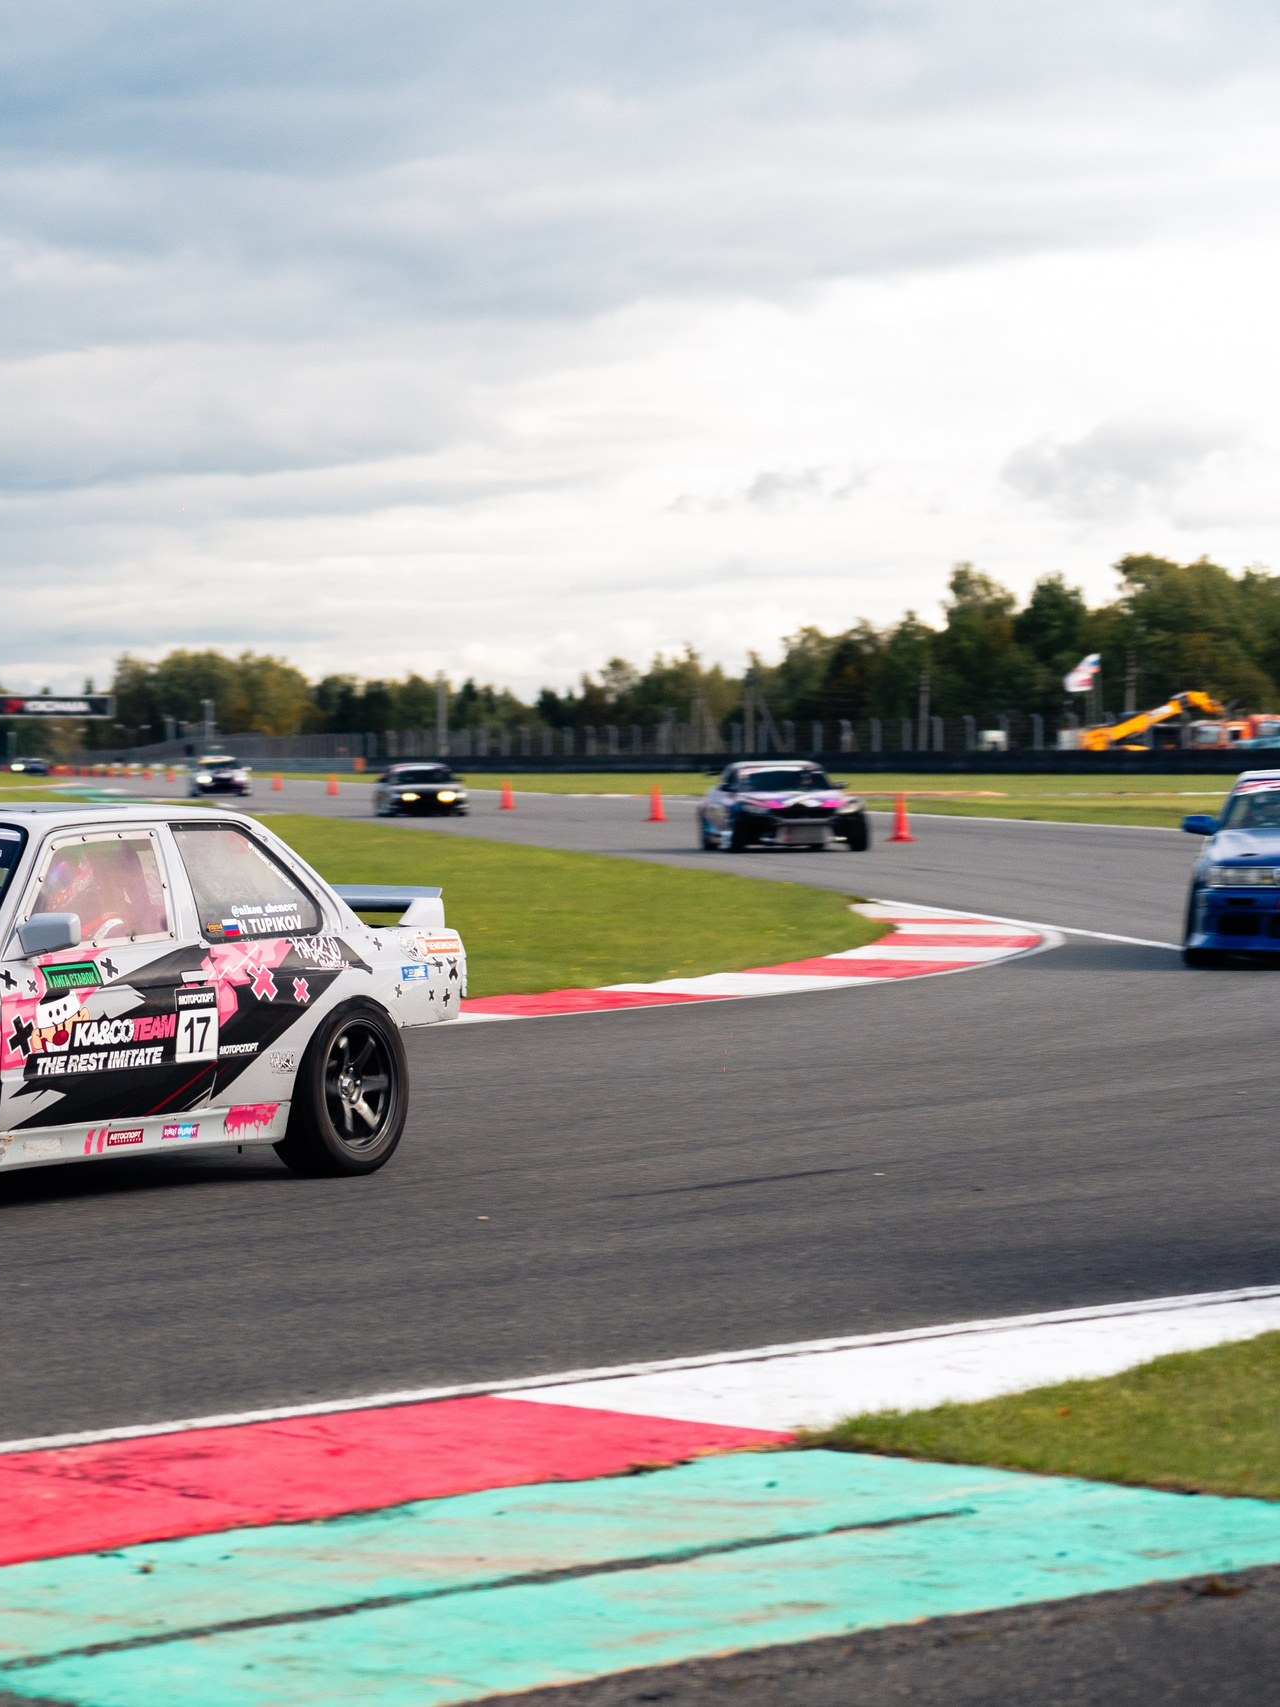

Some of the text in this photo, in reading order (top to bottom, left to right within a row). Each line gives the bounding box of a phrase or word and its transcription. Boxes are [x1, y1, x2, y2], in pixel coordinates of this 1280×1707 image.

[231, 903, 298, 917] @nikon_shencev
[237, 919, 248, 934] N
[248, 915, 302, 933] TUPIKOV
[52, 971, 97, 988] ЛИГА СТАВОК
[184, 1015, 211, 1053] 17
[37, 1046, 164, 1076] THE REST IMITATE
[109, 1130, 142, 1141] АВТОСПОРТ
